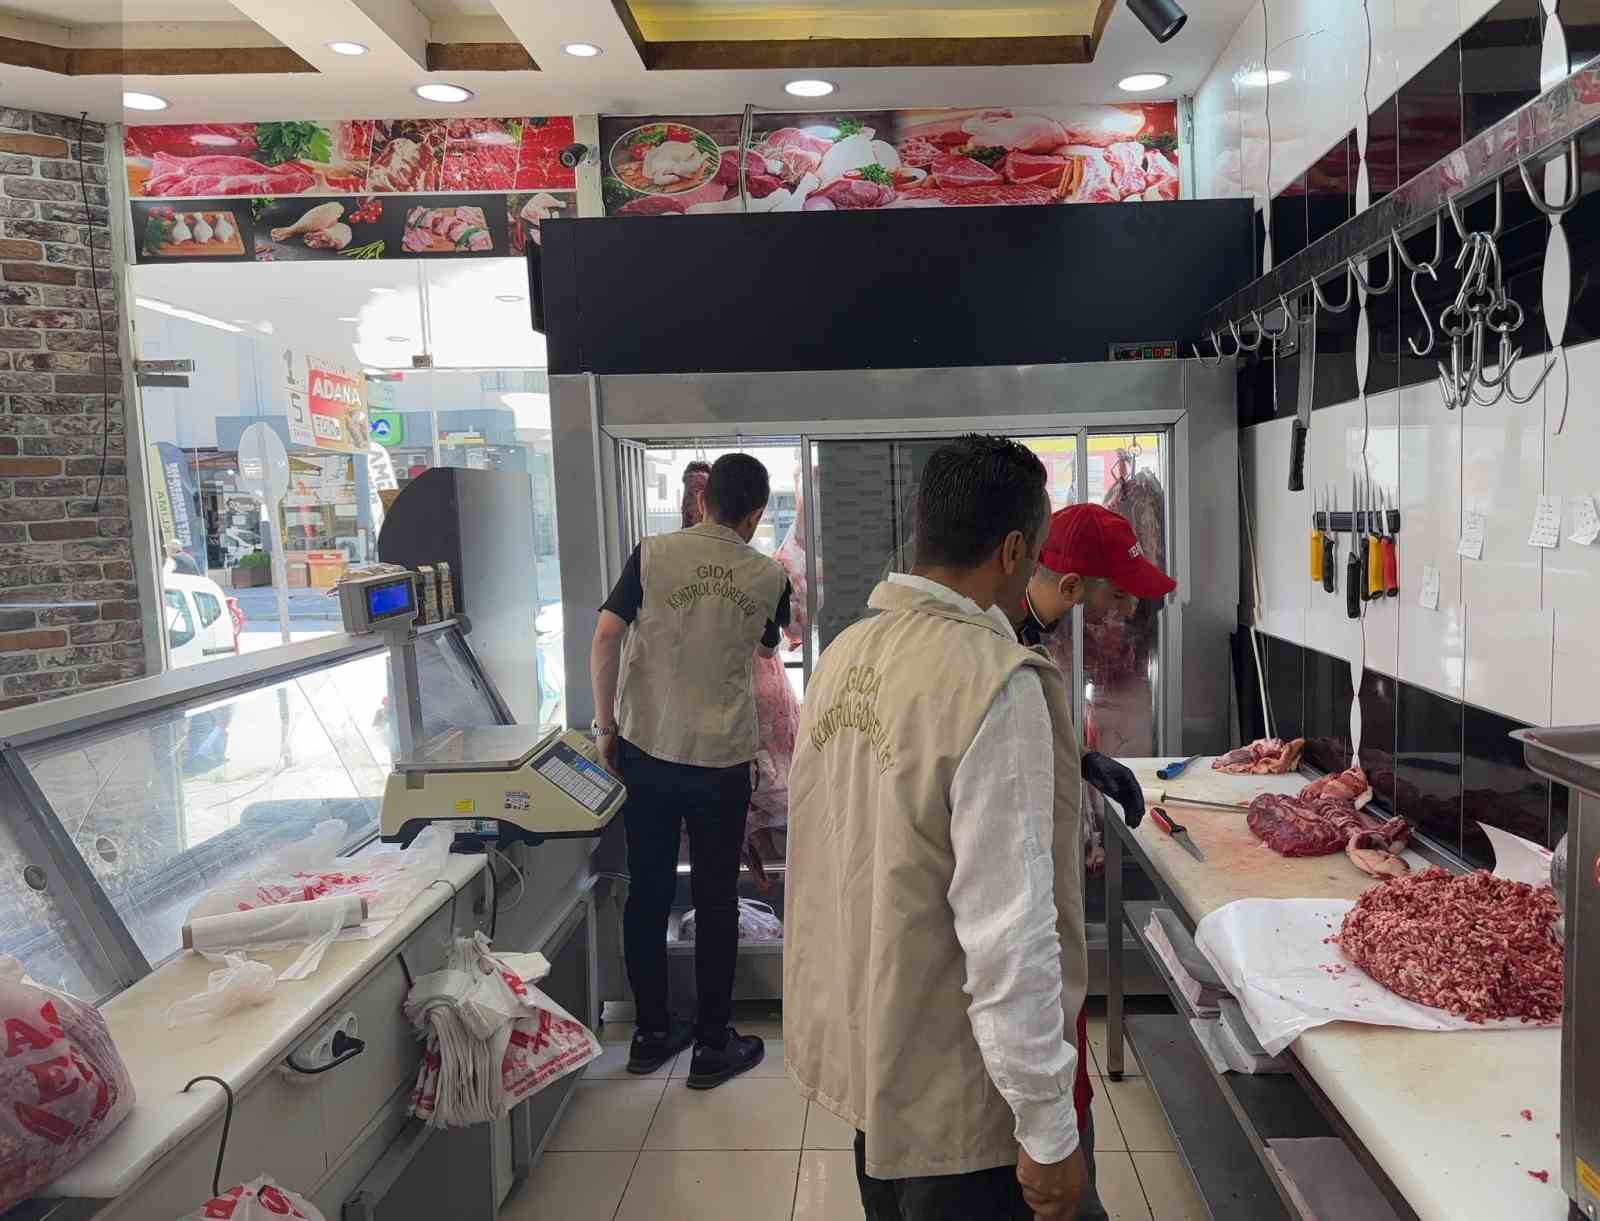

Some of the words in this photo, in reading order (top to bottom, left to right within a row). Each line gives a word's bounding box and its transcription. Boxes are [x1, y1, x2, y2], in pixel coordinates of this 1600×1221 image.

[311, 376, 362, 407] ADANA
[696, 564, 734, 582] GIDA
[664, 581, 711, 610] KONTROL
[846, 665, 882, 701] GIDA
[809, 701, 853, 753] KONTROL
